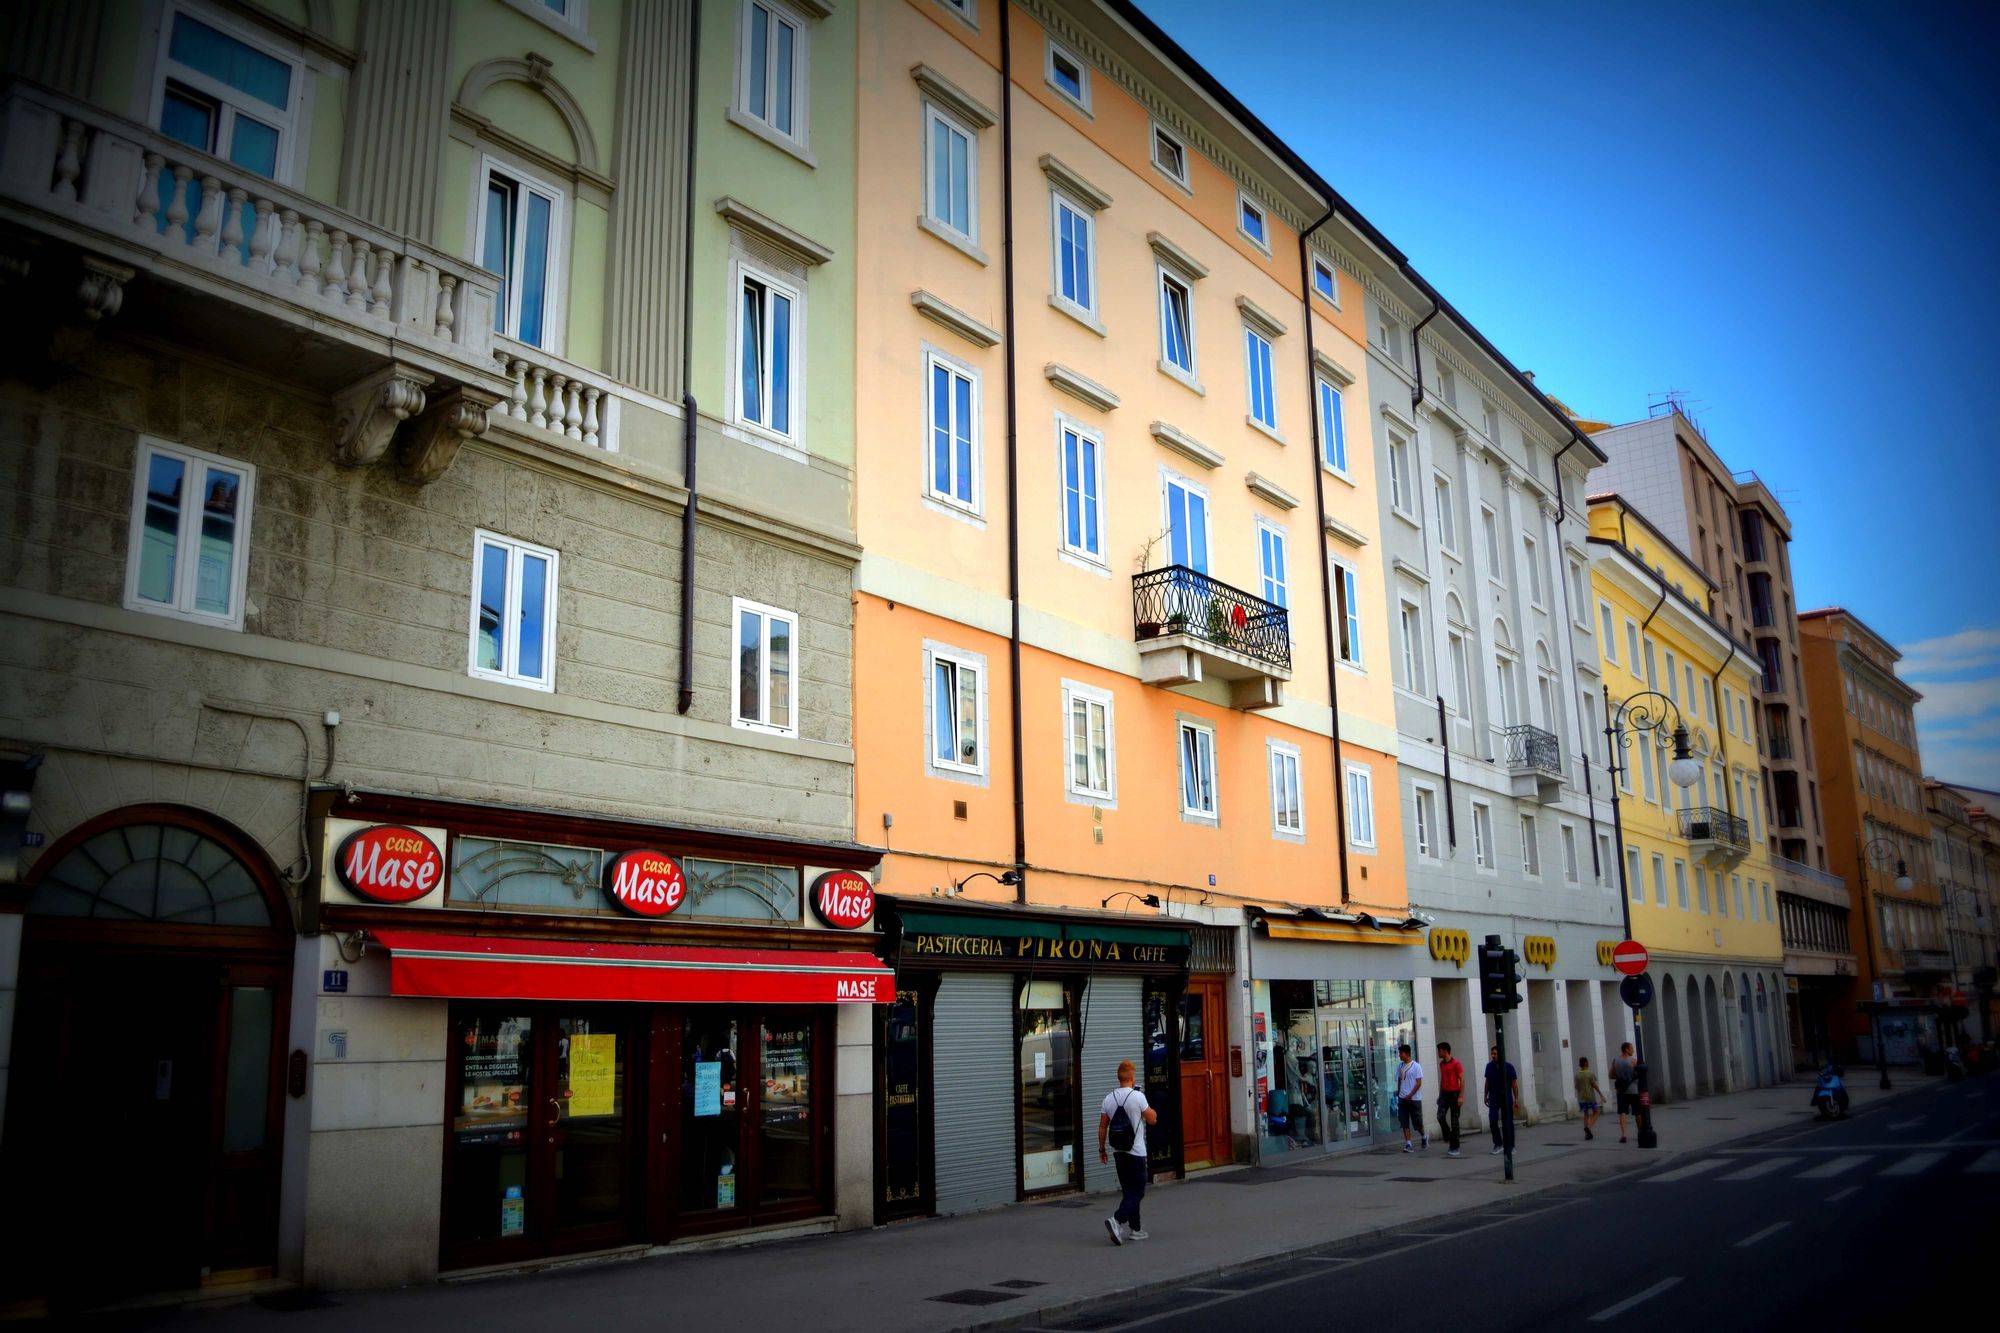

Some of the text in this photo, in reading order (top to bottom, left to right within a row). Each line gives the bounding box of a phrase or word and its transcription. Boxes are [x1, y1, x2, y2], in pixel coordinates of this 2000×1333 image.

[385, 836, 423, 853] casa
[345, 840, 435, 890] Masé
[642, 859, 672, 875] casa
[613, 861, 681, 906] Masé
[841, 879, 863, 892] casa
[820, 882, 871, 919] Masé
[916, 935, 1003, 956] PASTICCERIA
[1018, 936, 1120, 960] PIRONA
[1429, 927, 1470, 969] coop
[1524, 935, 1557, 971] coop
[330, 972, 341, 986] 11
